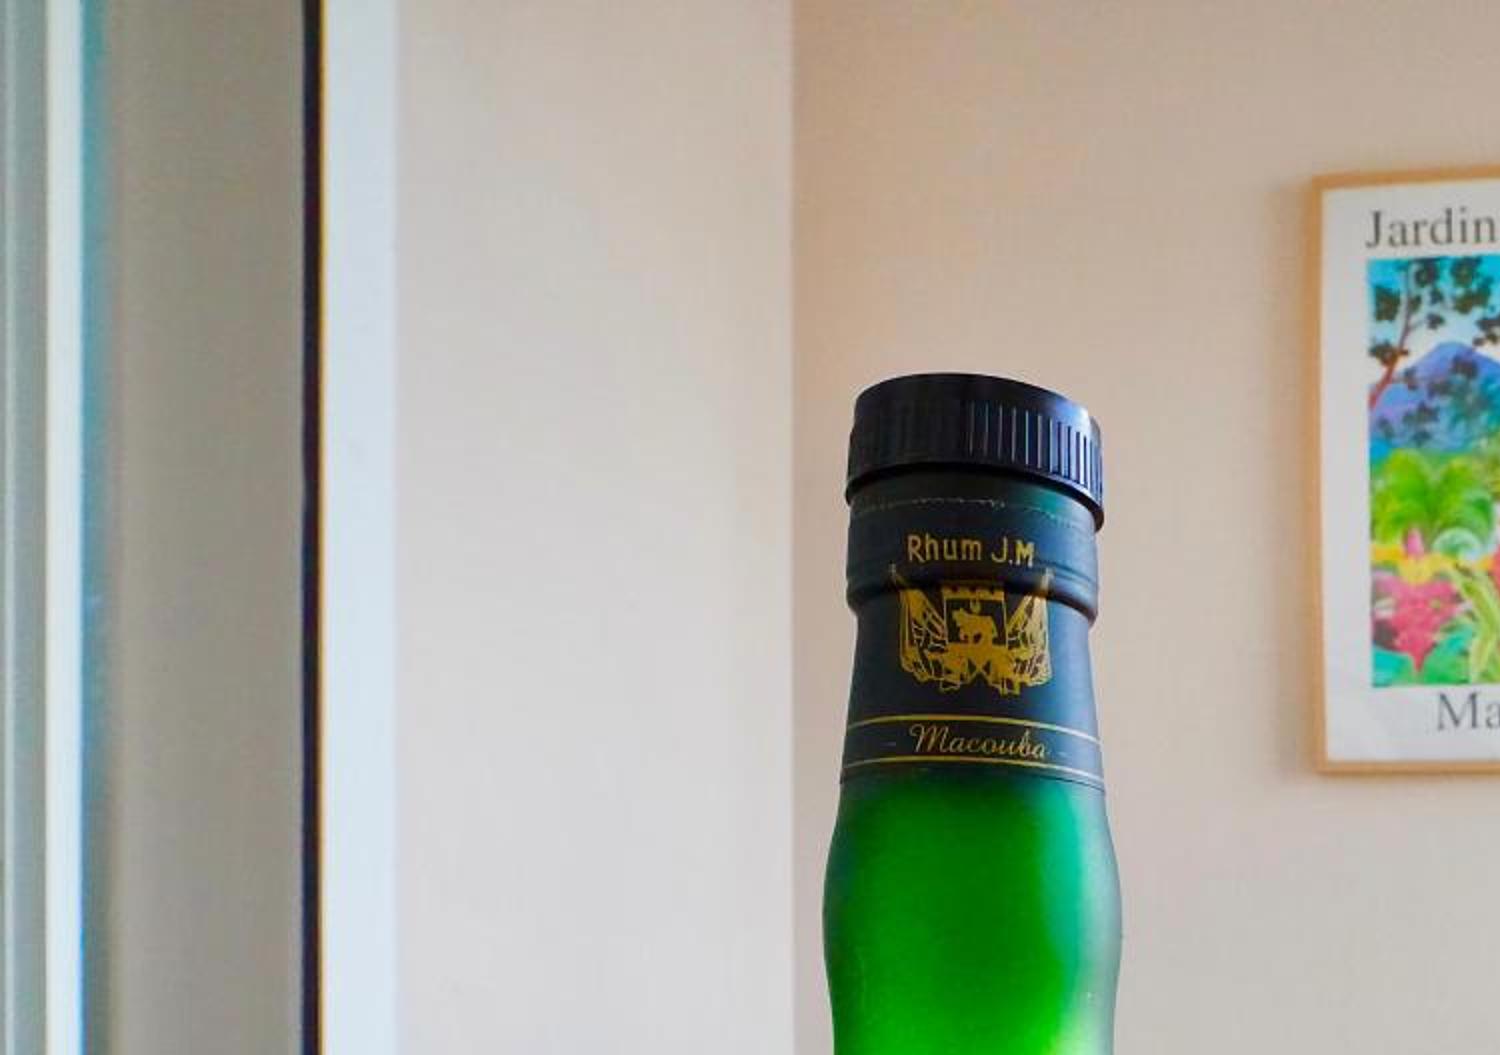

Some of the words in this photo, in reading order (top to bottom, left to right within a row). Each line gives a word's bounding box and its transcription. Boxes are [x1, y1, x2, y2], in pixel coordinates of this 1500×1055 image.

[1365, 208, 1498, 250] Jardin
[906, 533, 982, 564] Rhum
[990, 535, 1036, 568] J.M
[909, 722, 1046, 760] Macouba
